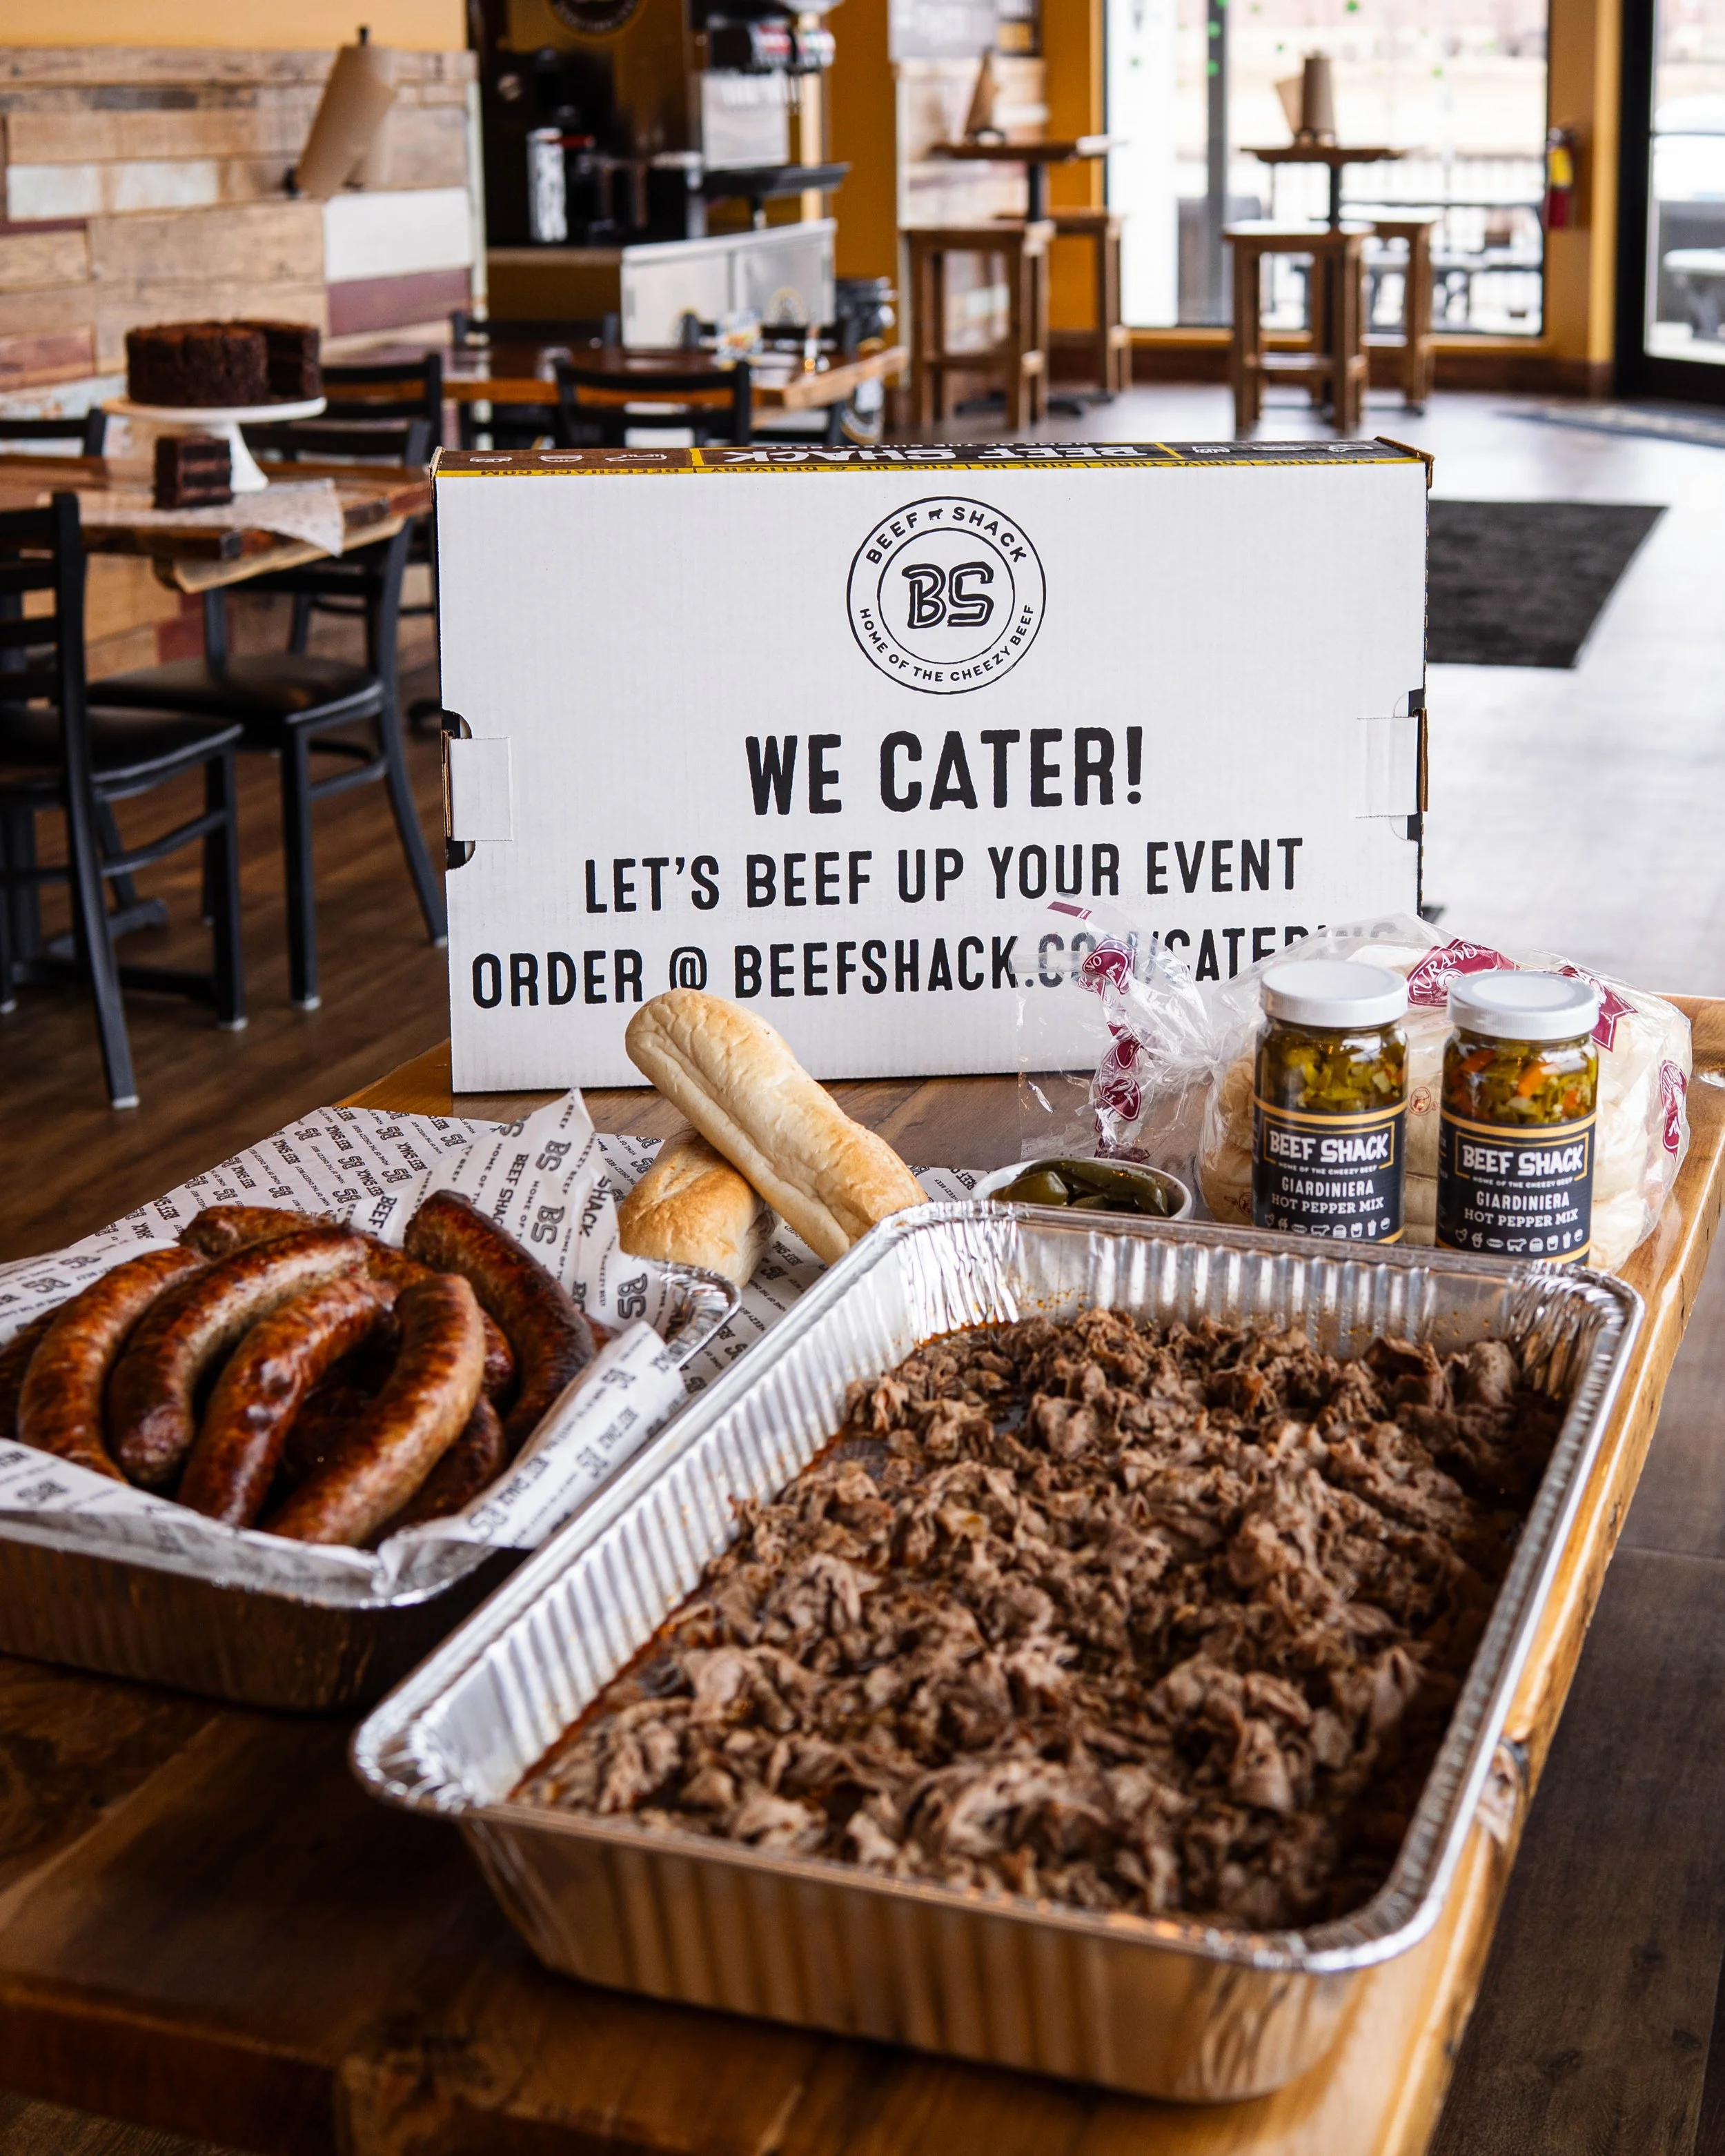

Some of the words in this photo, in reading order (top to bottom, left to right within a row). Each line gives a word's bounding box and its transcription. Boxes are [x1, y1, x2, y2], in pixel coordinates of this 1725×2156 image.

[722, 449, 956, 462] SHACK
[978, 446, 1147, 459] BEEF
[866, 512, 917, 564] BEEF
[952, 506, 1027, 563] SHACK
[902, 562, 994, 629] BS
[860, 609, 888, 653] HOME
[889, 654, 909, 670] OF
[914, 666, 943, 682] THE
[949, 646, 1011, 682] CHEEZY
[1009, 605, 1034, 646] BEEF
[745, 734, 842, 815] WE
[880, 726, 1143, 812] CATER!
[585, 856, 719, 913] LET'S
[747, 851, 871, 908] BEEF
[898, 848, 963, 902] UP
[988, 843, 1118, 899] YOUR
[1147, 838, 1302, 894] EVENT
[1413, 942, 1477, 996] TURANO
[472, 949, 642, 1009] ORDER
[669, 947, 707, 991] @
[559, 1103, 575, 1129] BEEF
[324, 1124, 344, 1140] SHACK
[351, 1124, 362, 1133] BEEF
[375, 1125, 404, 1140] BS
[431, 1118, 450, 1131] BEEF
[466, 1125, 475, 1134] HOME
[293, 1127, 321, 1141] BS
[358, 1132, 372, 1145] CHEEZY
[440, 1134, 466, 1147] BS
[270, 1138, 292, 1154] SHACK
[334, 1138, 353, 1151] BEEF
[395, 1141, 417, 1160] SHACK
[624, 1145, 636, 1155] HOME
[1270, 1130, 1316, 1160] BEEF
[1321, 1133, 1389, 1163] SHACK
[281, 1152, 300, 1164] BEEF
[337, 1155, 365, 1170] BS
[378, 1155, 390, 1166] HOME
[406, 1157, 427, 1171] BEEF
[484, 1143, 503, 1172] HOME
[535, 1140, 571, 1172] BS
[604, 1158, 617, 1166] BEEF
[1462, 1145, 1514, 1174] BEEF
[1517, 1144, 1584, 1176] SHACK
[230, 1164, 250, 1180] SHACK
[381, 1169, 413, 1184] BS
[451, 1158, 466, 1183] BEEF
[506, 1153, 530, 1187] BEEF
[614, 1166, 630, 1178] CHEEZY
[1279, 1162, 1297, 1172] HOME
[1311, 1167, 1326, 1175] THE
[239, 1176, 256, 1189] BEEF
[335, 1173, 345, 1184] HOME
[355, 1168, 377, 1187] SHACK
[478, 1174, 488, 1189] OF
[562, 1170, 579, 1196] BEEF
[934, 1178, 946, 1188] BEEF
[956, 1171, 978, 1190] BEEF
[213, 1187, 237, 1201] BS
[268, 1185, 293, 1198] BS
[1281, 1176, 1374, 1198] GIARDINIERA
[319, 1196, 331, 1206] HOME
[332, 1187, 362, 1204] BS
[472, 1191, 482, 1205] TH
[524, 1180, 540, 1211] HOME
[1476, 1191, 1570, 1211] GIARDINIERA
[492, 1187, 514, 1226] SHAC
[579, 1176, 612, 1238] SHACK
[1272, 1194, 1298, 1209] HOT
[1301, 1201, 1356, 1214] PEPPER
[1359, 1196, 1384, 1212] MIX
[156, 1205, 180, 1220] BEEF
[368, 1196, 397, 1229] BEEF
[1464, 1207, 1494, 1225] HOT
[1498, 1214, 1552, 1228] PEPPER
[1555, 1208, 1579, 1225] MIX
[518, 1214, 528, 1228] OF
[531, 1205, 565, 1245] BS
[618, 1273, 648, 1319] BS
